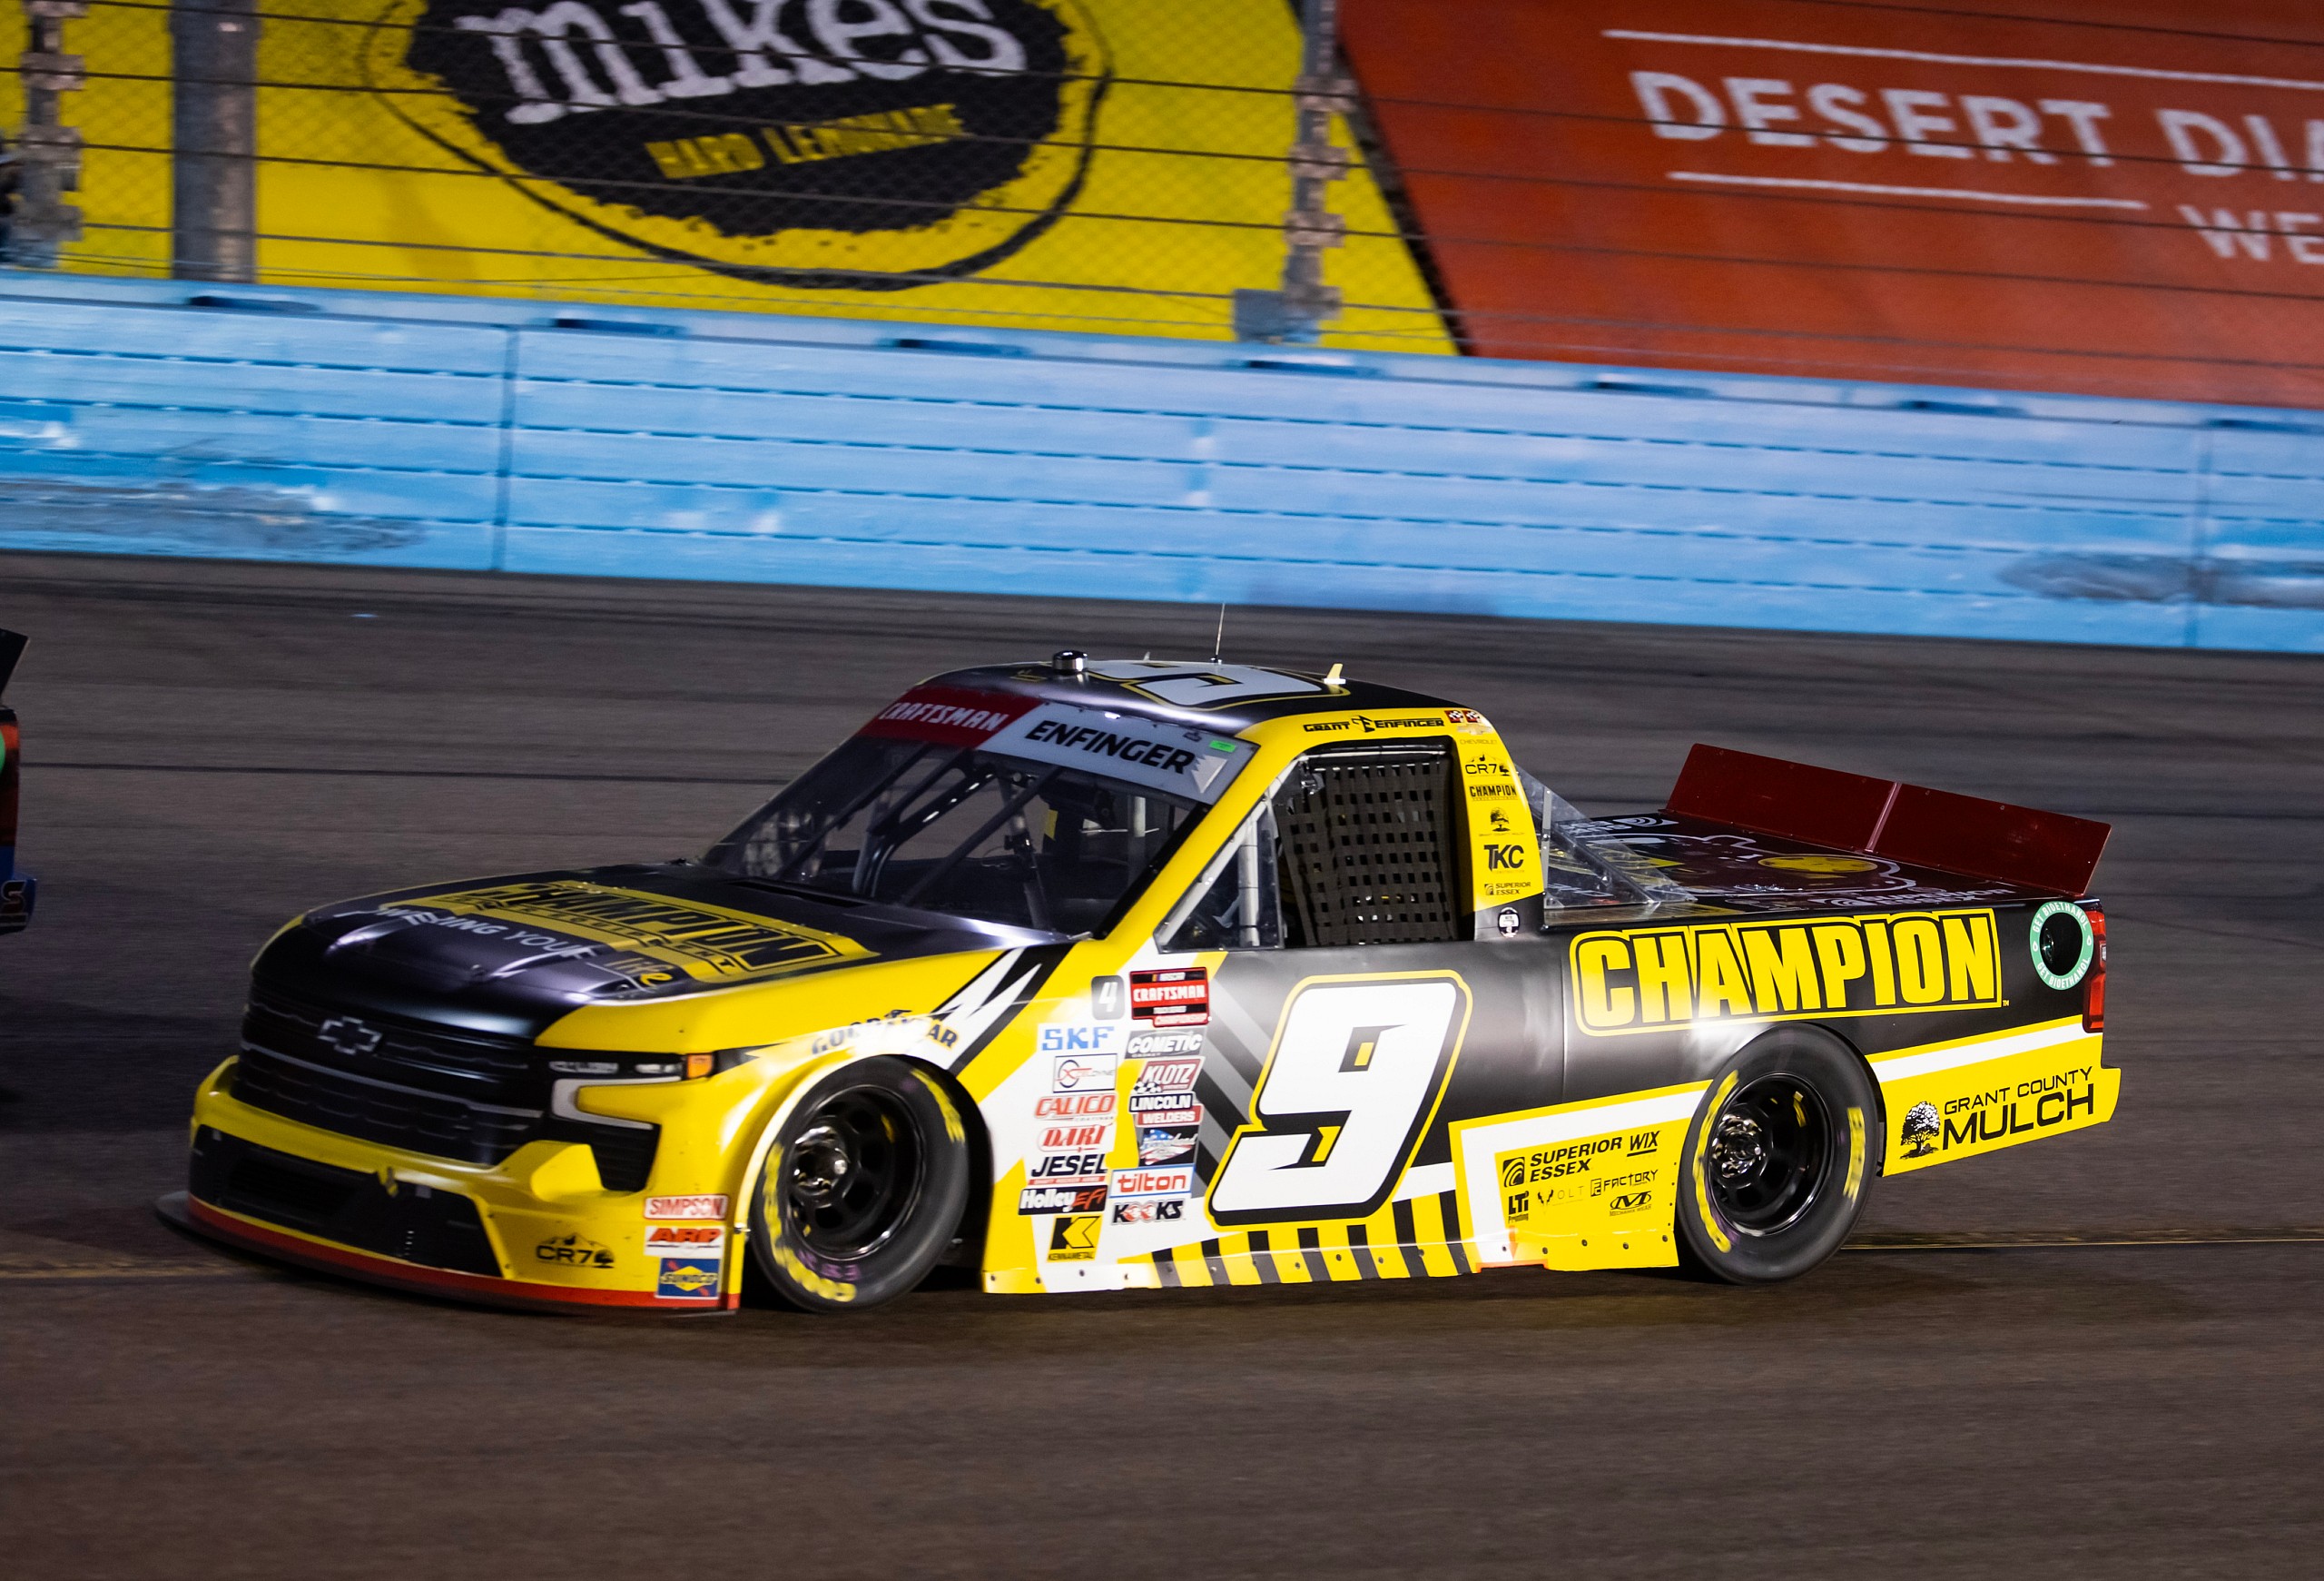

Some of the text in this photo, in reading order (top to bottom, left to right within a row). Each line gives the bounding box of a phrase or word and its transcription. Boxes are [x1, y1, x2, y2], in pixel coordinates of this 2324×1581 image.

[1630, 70, 2115, 166] DESERT
[878, 702, 1009, 732] CRAFTSMAN
[1374, 717, 1445, 728] ENFINGER
[1025, 720, 1196, 775] ENFINGER
[1464, 764, 1498, 775] CR7
[1469, 784, 1518, 798] CHAMPION
[1483, 845, 1525, 872] TKC
[1495, 882, 1531, 890] SUPERIOR
[2033, 902, 2090, 933] GET BIOETHANOL
[1577, 914, 1996, 1029] CHAMPION
[2037, 957, 2091, 989] GET BIOETHANOL
[1098, 982, 1118, 1013] 4
[1133, 985, 1206, 1003] CRAFTSMAN
[1041, 1026, 1115, 1051] SKF
[1128, 1034, 1204, 1054] COMETIC
[1141, 1063, 1196, 1085] KLOTZ
[1209, 980, 1459, 1214] 9
[1944, 1066, 2093, 1115] GRANT COUNTY
[1035, 1094, 1116, 1117] CALICO
[1131, 1095, 1191, 1112] LINCOLN
[1143, 1111, 1196, 1125] WELDERS
[1942, 1083, 2094, 1151] MULCH
[1043, 1123, 1113, 1147] DART
[1530, 1131, 1660, 1167] SUPERIOR WIX
[1031, 1154, 1108, 1177] JESEL
[1530, 1159, 1591, 1182] ESSEX
[1118, 1173, 1187, 1193] tilton
[1604, 1169, 1659, 1191] FACTORY
[650, 1198, 726, 1217] SIMPSON
[1019, 1189, 1078, 1212] Holley
[648, 1227, 723, 1243] ARP
[536, 1245, 594, 1264] CR7
